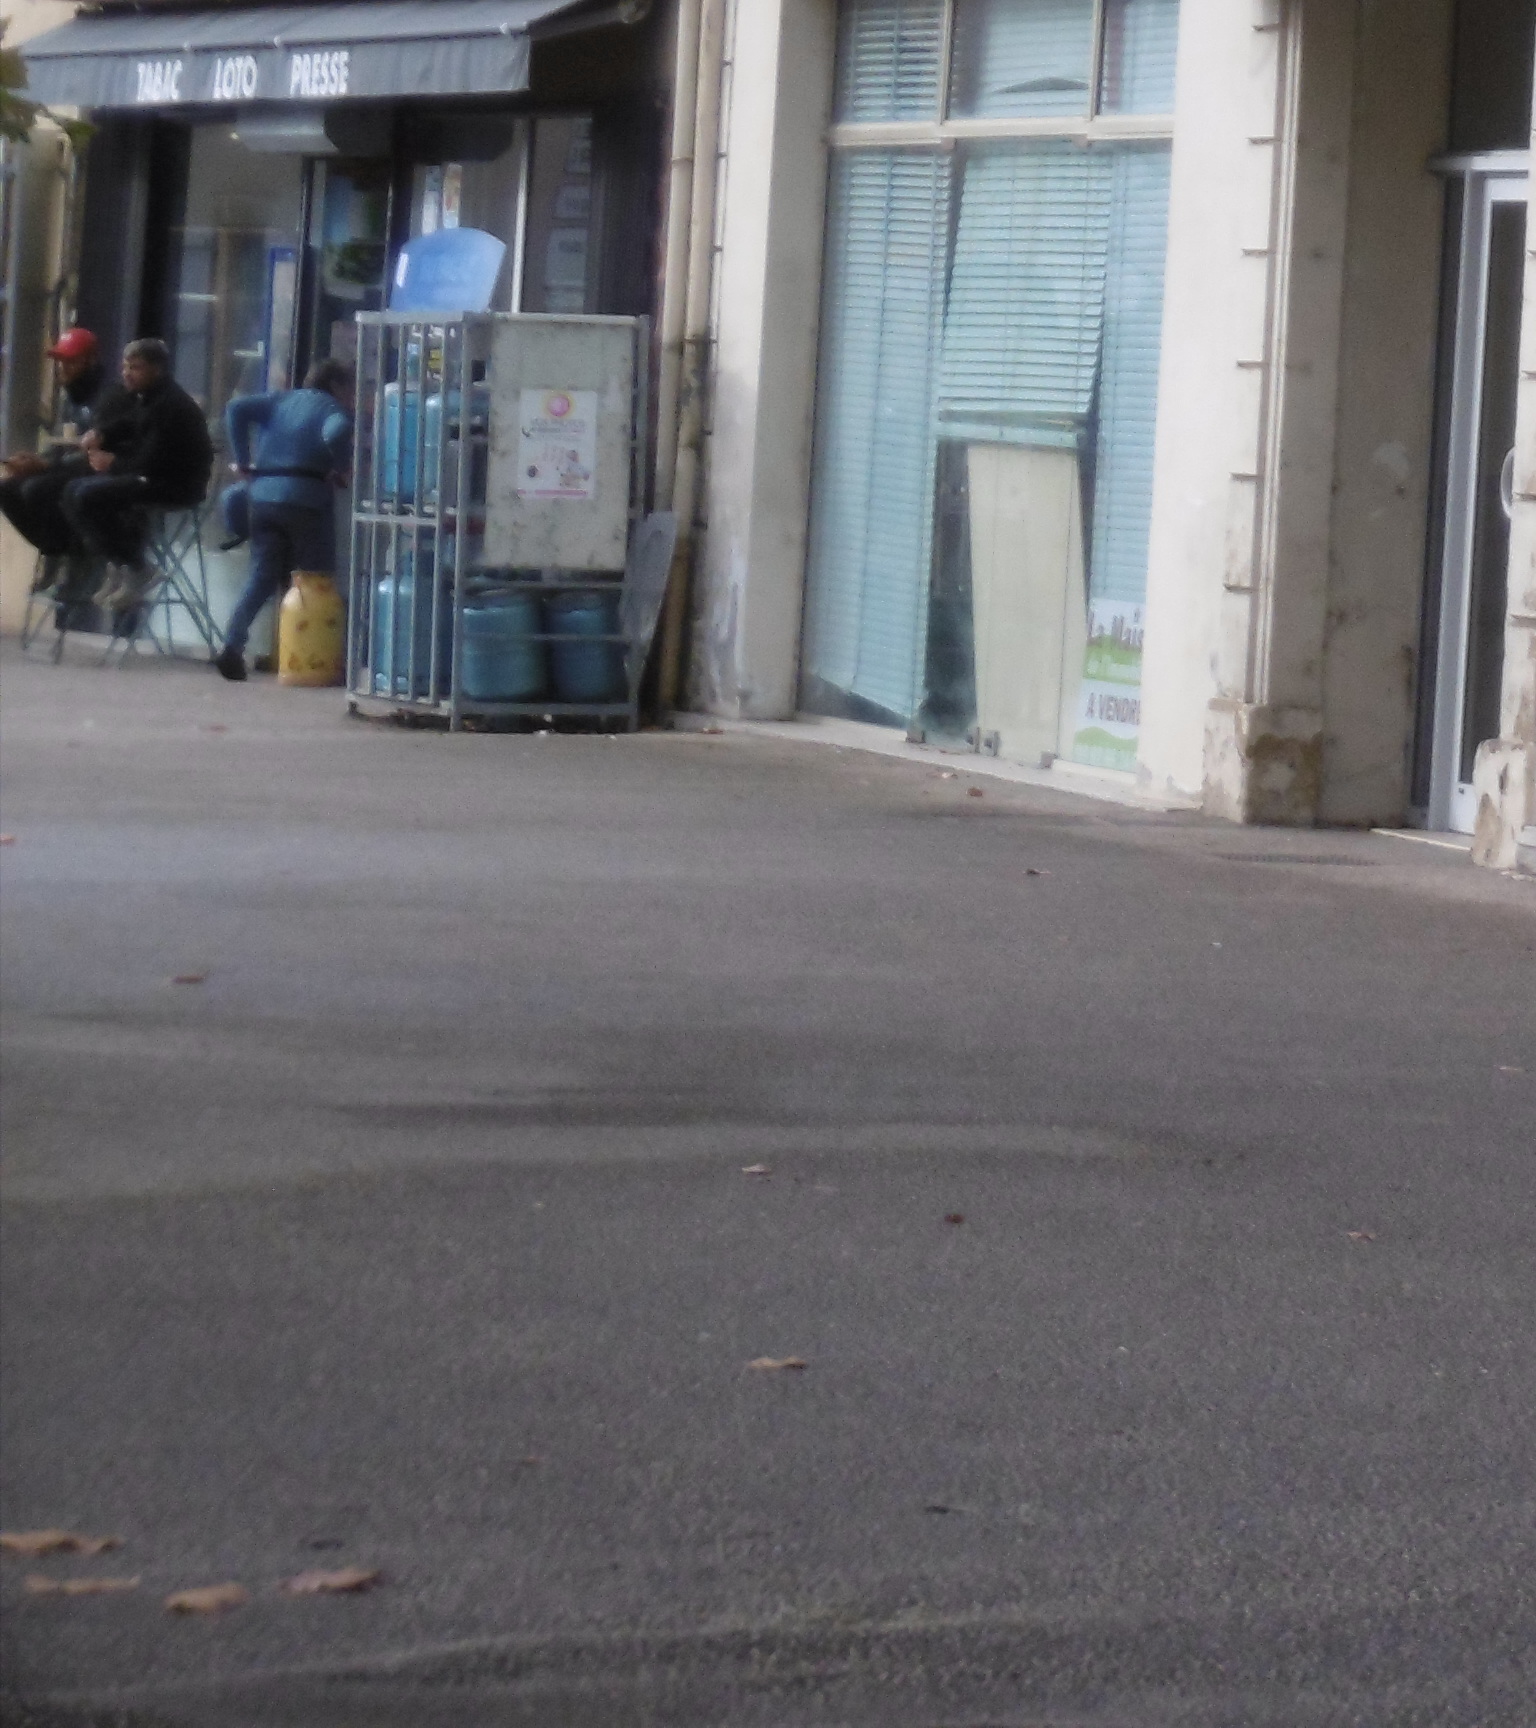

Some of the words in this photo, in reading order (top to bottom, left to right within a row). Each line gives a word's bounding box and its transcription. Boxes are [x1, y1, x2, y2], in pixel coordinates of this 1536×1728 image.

[137, 59, 183, 103] TABAC
[212, 54, 258, 99] LOTO
[290, 51, 350, 97] PRESSE
